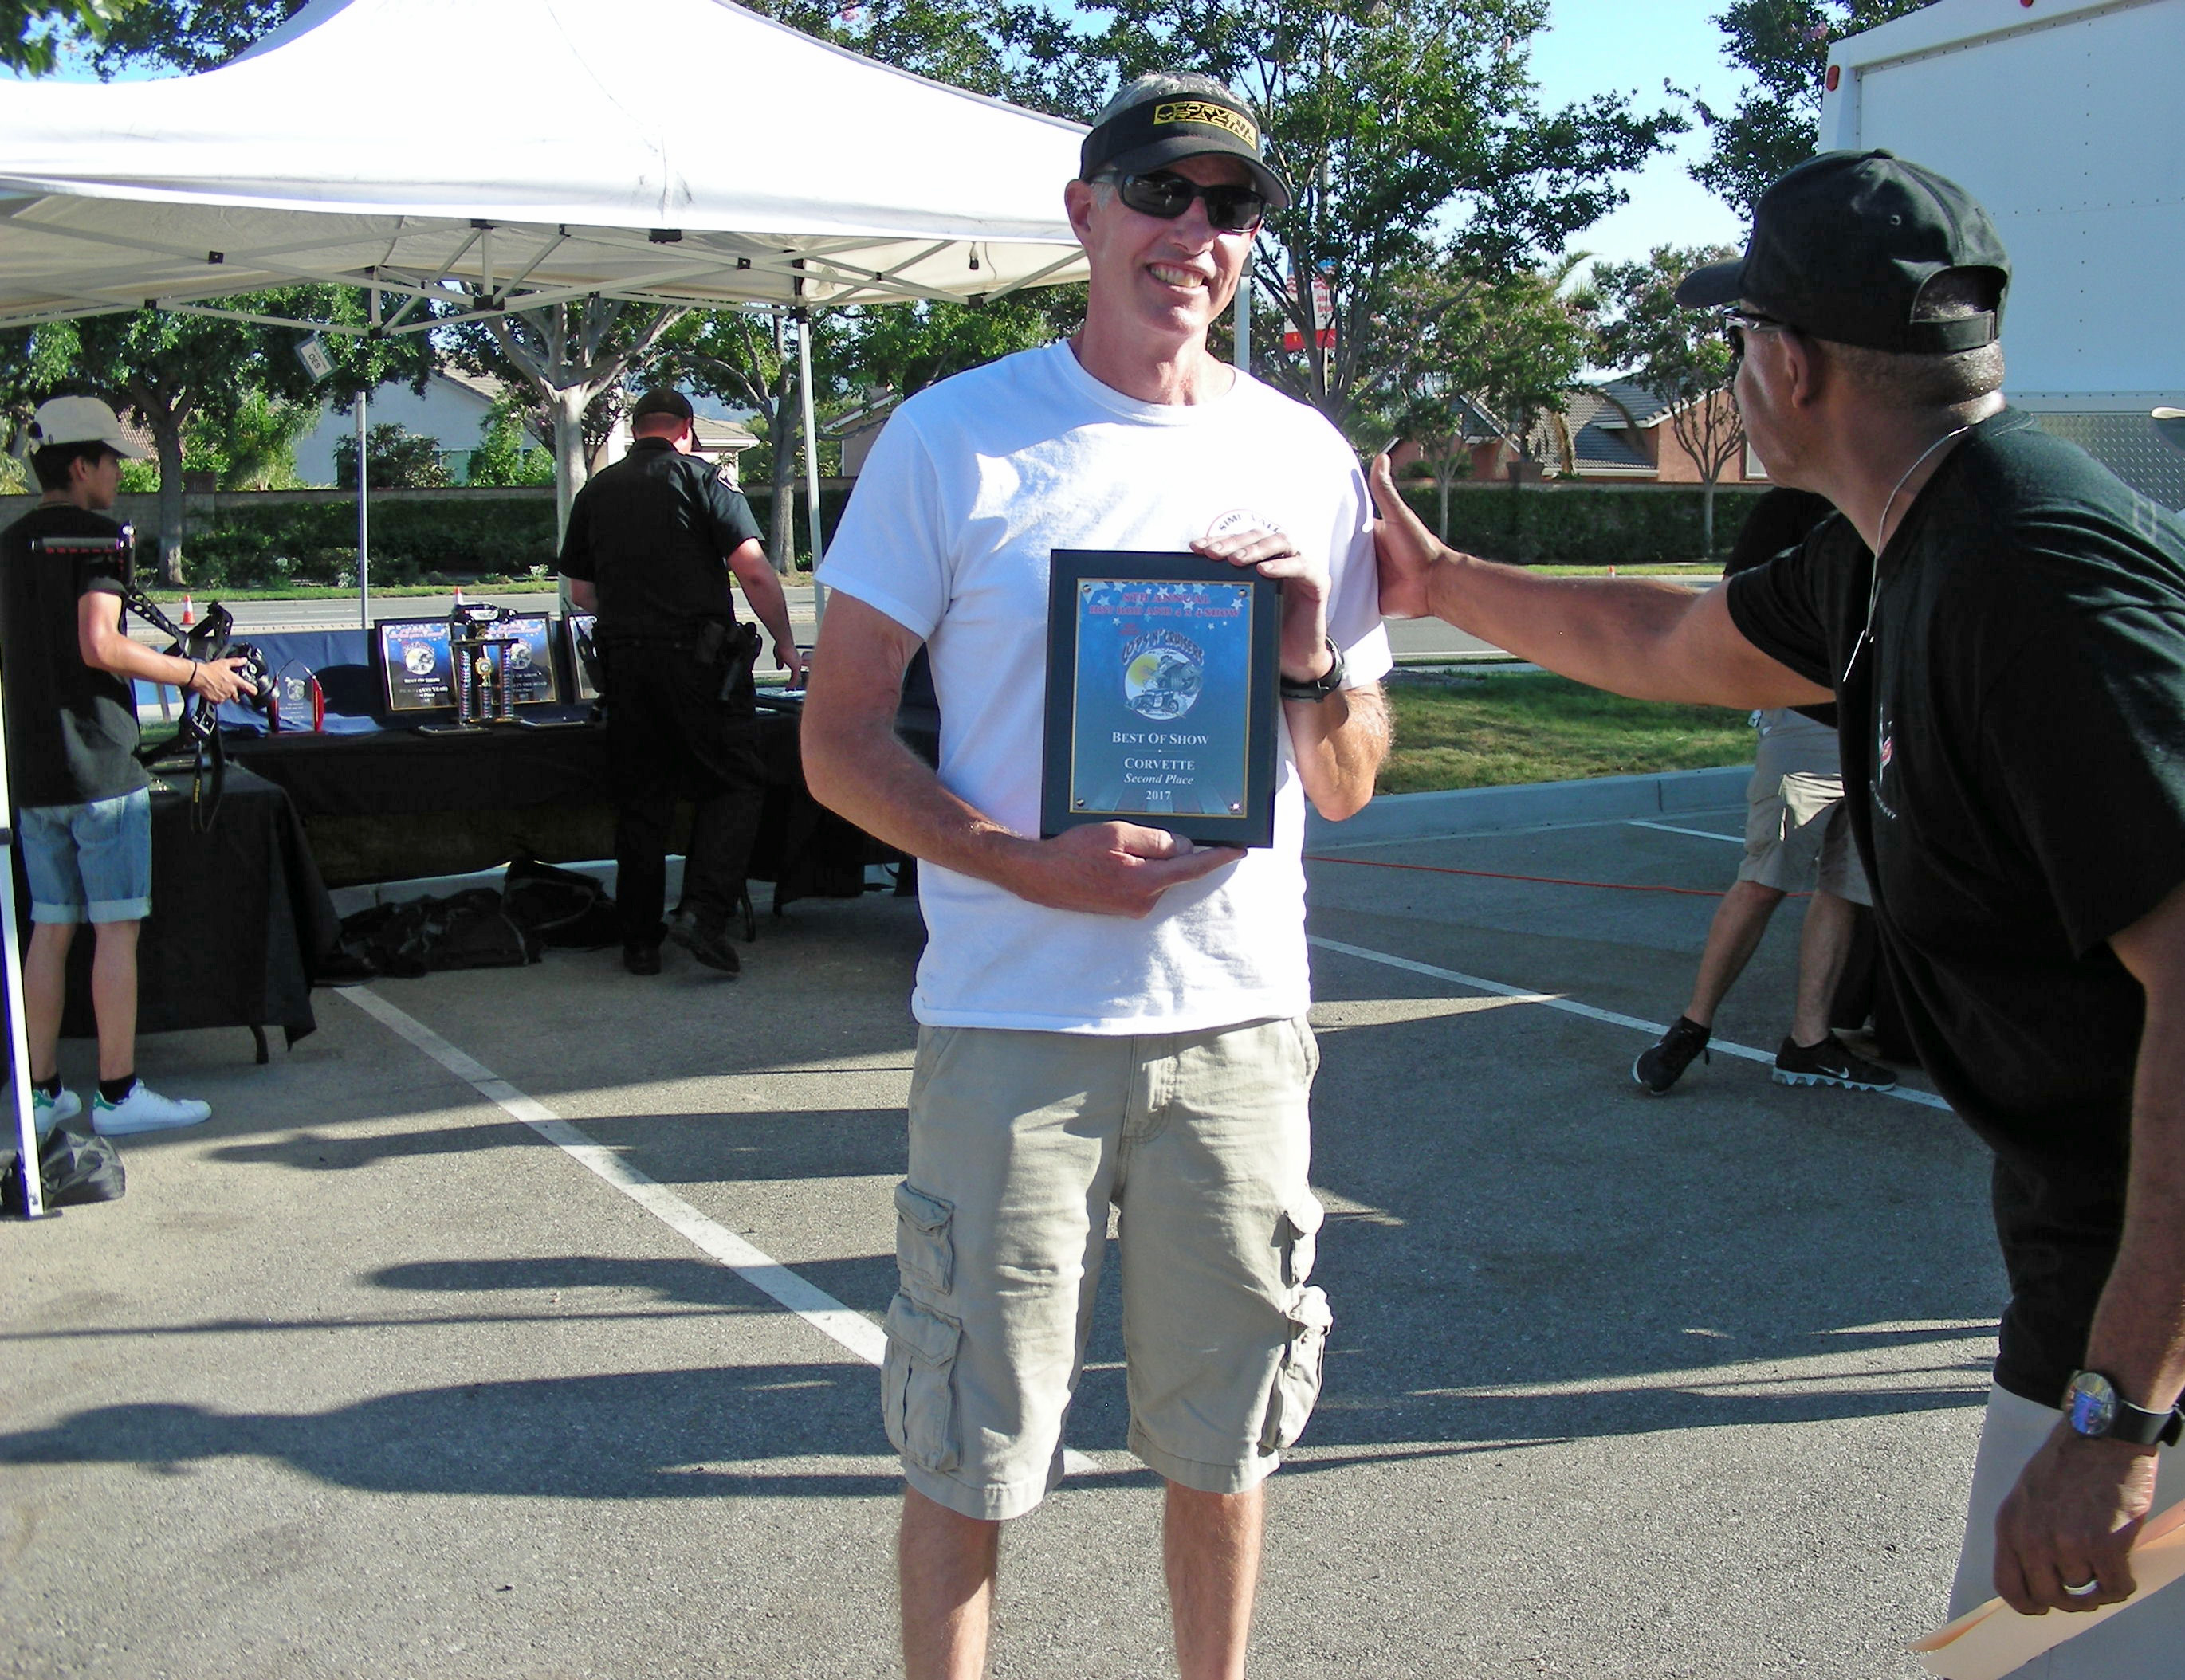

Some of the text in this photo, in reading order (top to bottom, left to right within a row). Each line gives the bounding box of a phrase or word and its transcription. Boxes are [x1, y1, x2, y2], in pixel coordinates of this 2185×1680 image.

[1174, 104, 1256, 134] CORVET
[1219, 513, 1241, 532] SIMI
[1153, 593, 1210, 604] ANNUAL
[1090, 606, 1114, 614] HOT
[1117, 606, 1142, 615] ROD
[1146, 606, 1173, 616] AND
[1205, 608, 1240, 617] SHOW
[1112, 732, 1209, 745] BEST OF SHOW
[1124, 757, 1196, 771] CORVETTE
[1123, 772, 1194, 785] Second Place
[1146, 790, 1172, 801] 2017
